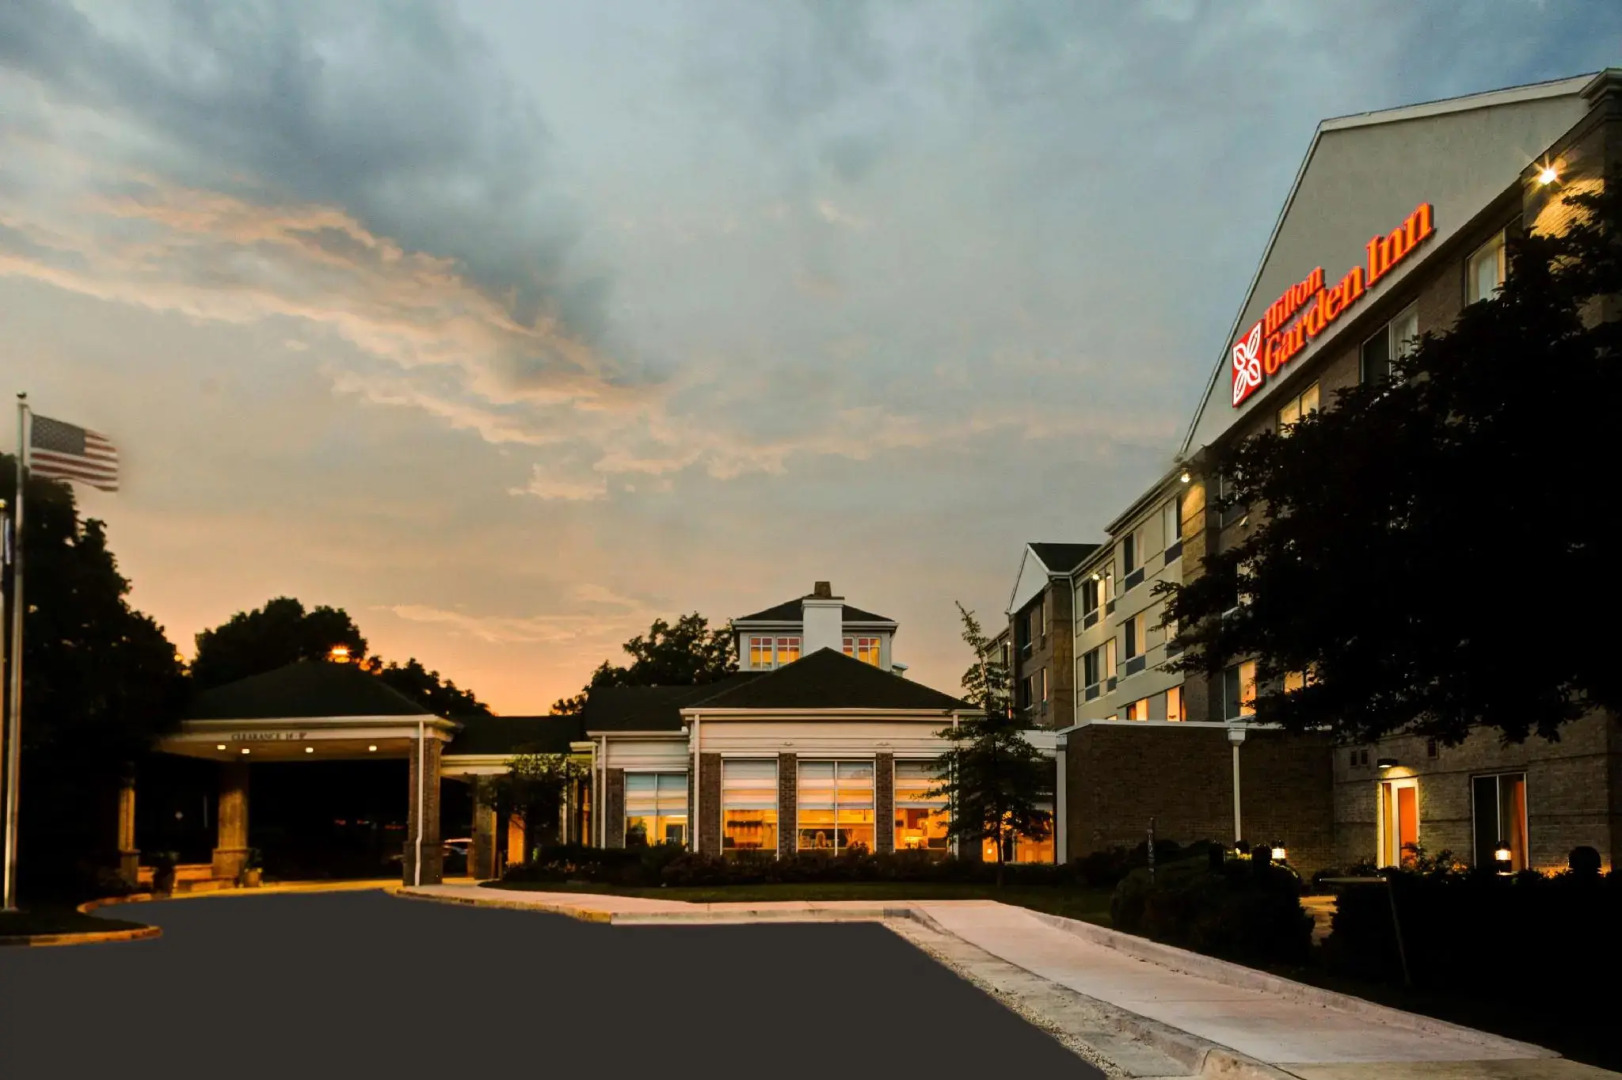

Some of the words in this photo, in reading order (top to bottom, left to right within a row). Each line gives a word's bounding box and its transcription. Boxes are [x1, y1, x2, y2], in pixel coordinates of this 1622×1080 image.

[1264, 266, 1324, 338] Hilton
[1265, 265, 1364, 375] Garden
[1366, 202, 1432, 287] Inn
